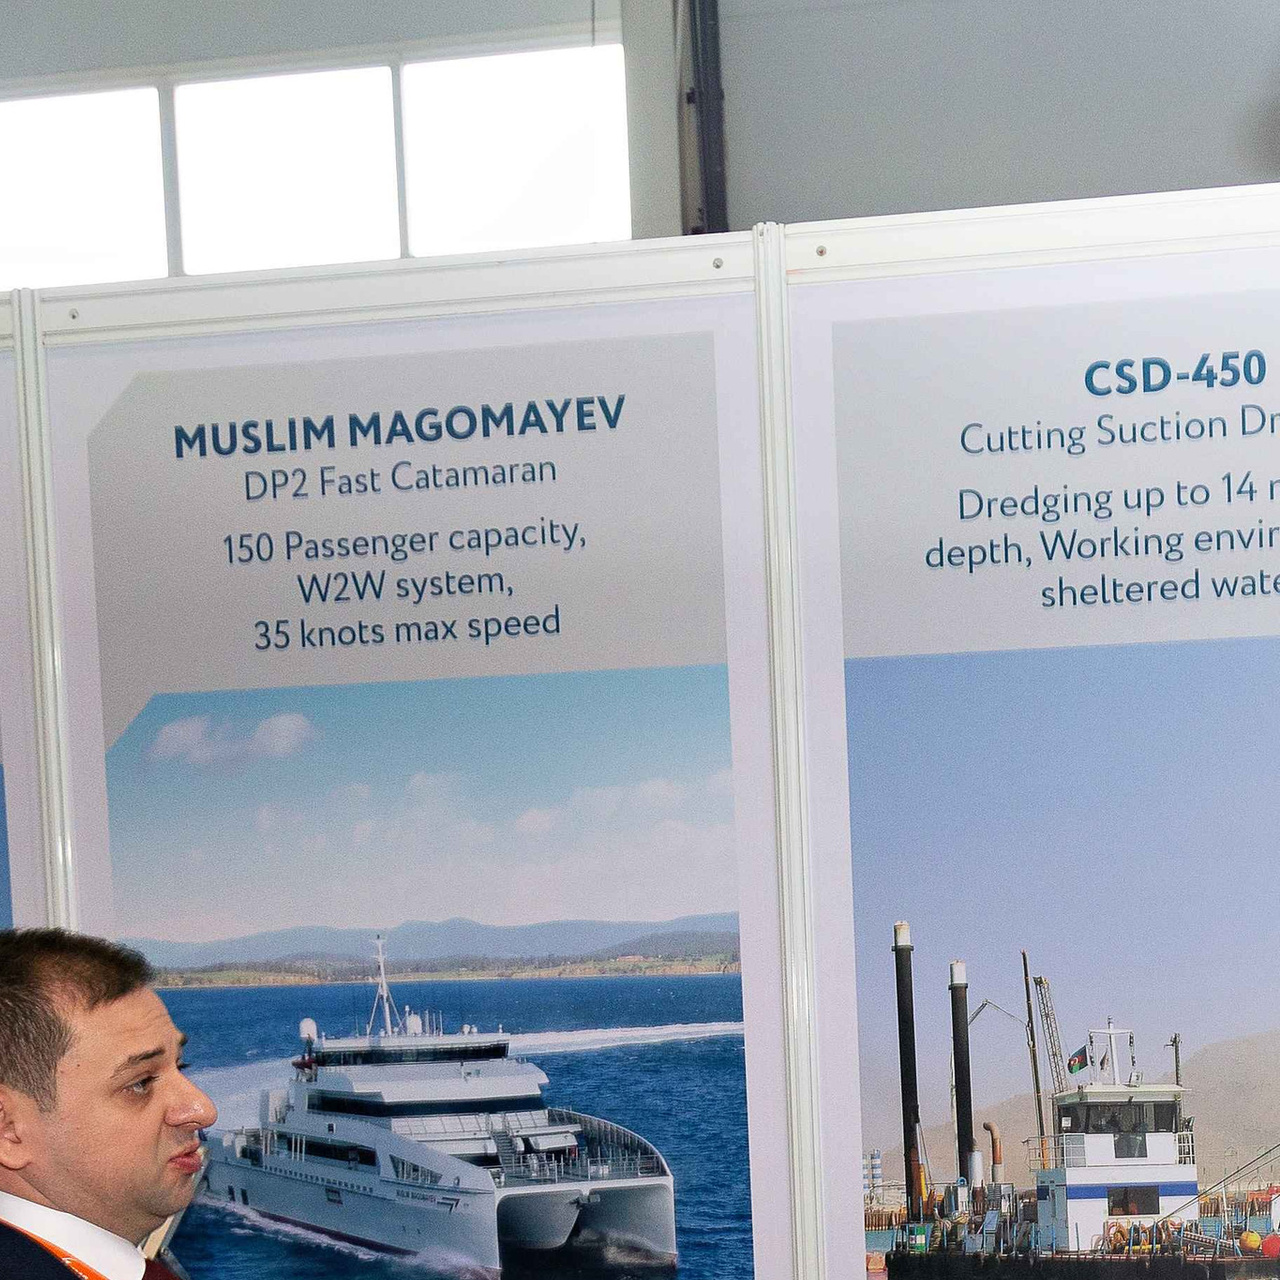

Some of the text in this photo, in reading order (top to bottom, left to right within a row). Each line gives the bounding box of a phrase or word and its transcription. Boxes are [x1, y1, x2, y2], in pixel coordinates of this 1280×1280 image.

[1084, 350, 1267, 397] CSD-450
[174, 394, 625, 459] MUSLIM MAGOMAYEV
[960, 422, 1086, 456] Cutting
[1096, 413, 1227, 446] Suction
[244, 460, 557, 502] DP2 Fast Catamaran
[958, 484, 1113, 523] Dredging
[1123, 487, 1165, 518] up
[1176, 481, 1211, 507] to
[1221, 471, 1258, 504] 14
[223, 517, 587, 565] 150 Passenger capacity,
[925, 533, 1032, 575] depth,
[1039, 526, 1184, 562] Working
[296, 569, 514, 605] W2W system,
[1041, 568, 1200, 608] sheltered
[254, 603, 562, 651] 35 knots max speed
